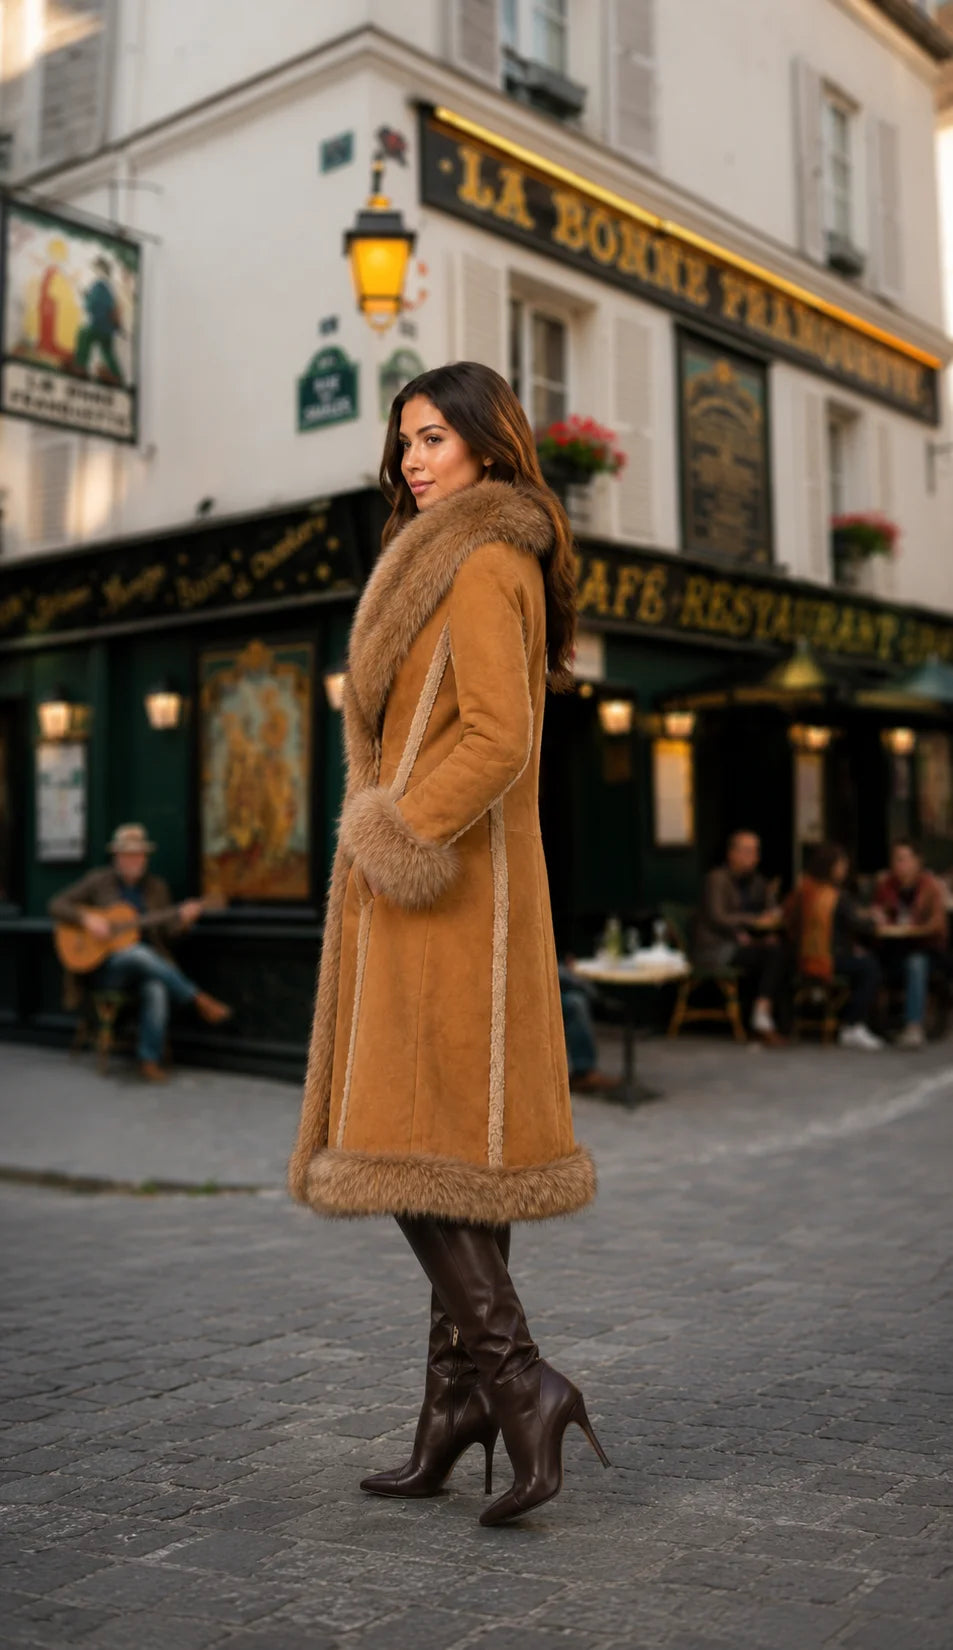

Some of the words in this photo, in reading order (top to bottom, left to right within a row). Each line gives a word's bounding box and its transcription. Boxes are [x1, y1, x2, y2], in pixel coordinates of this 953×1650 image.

[457, 145, 535, 231] LA
[552, 191, 709, 306] BONNE
[574, 555, 667, 625] AFÉ
[681, 574, 899, 660] RESTAURANT
